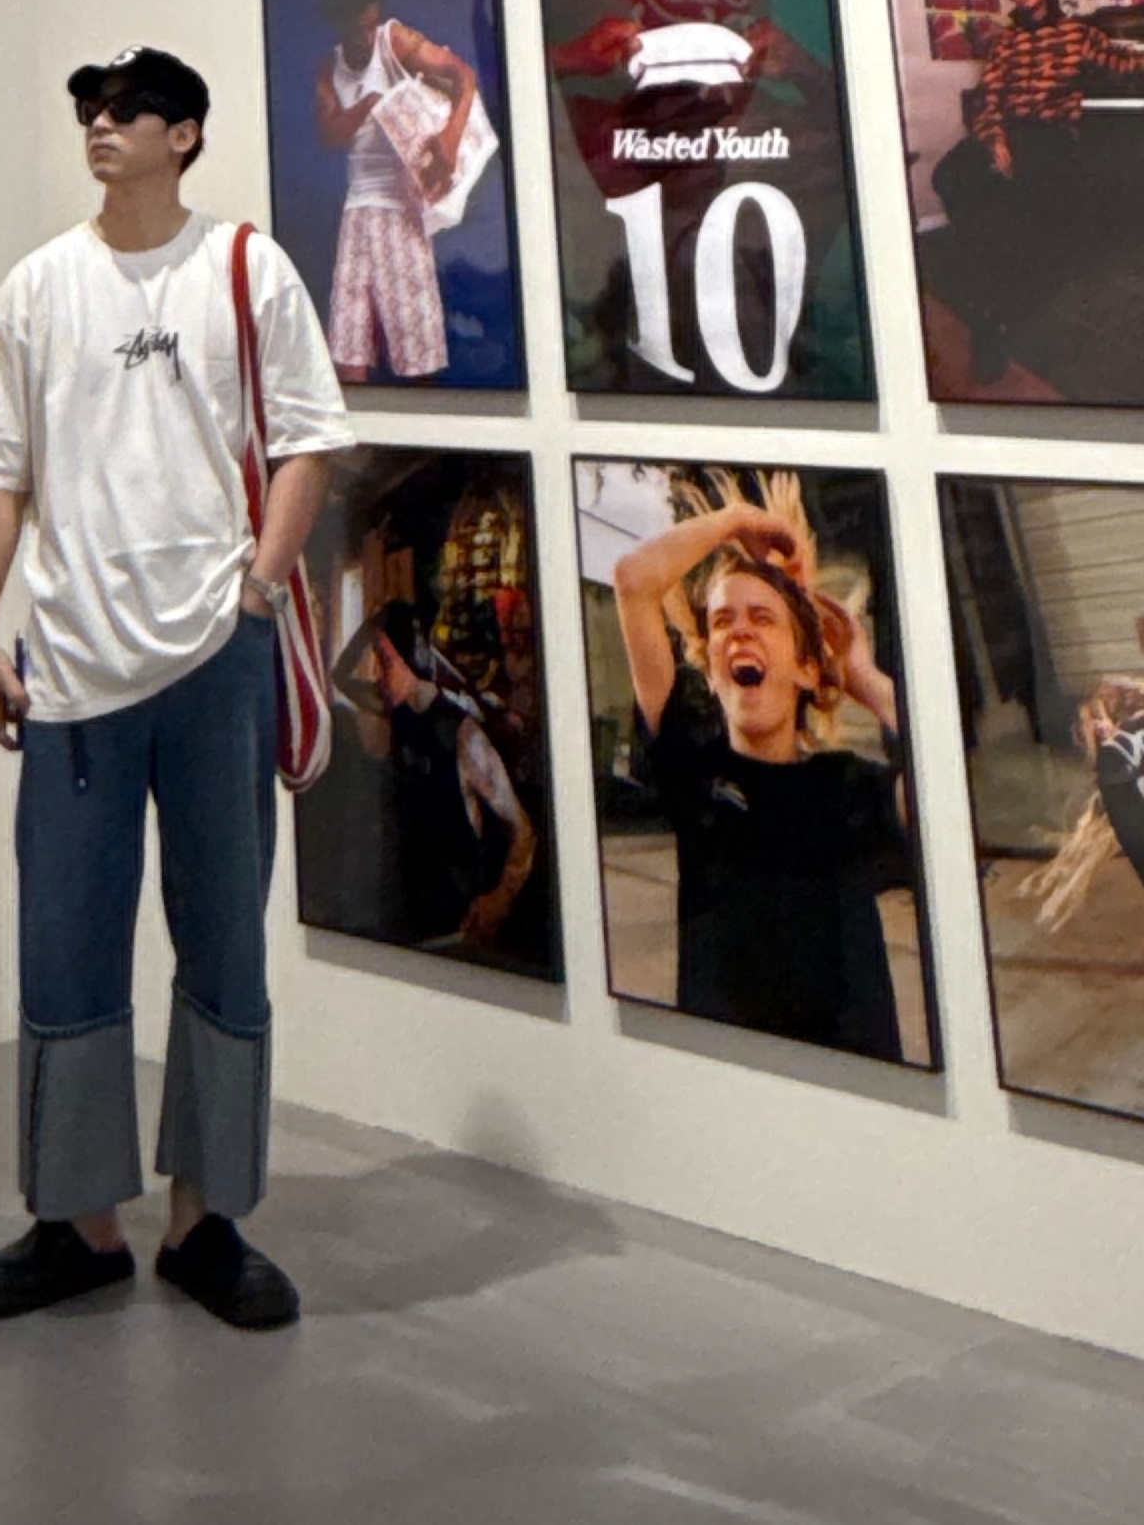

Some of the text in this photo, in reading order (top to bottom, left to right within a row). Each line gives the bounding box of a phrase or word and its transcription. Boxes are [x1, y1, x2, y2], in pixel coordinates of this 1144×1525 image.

[612, 126, 790, 160] Wasted Youth
[606, 181, 806, 393] 10
